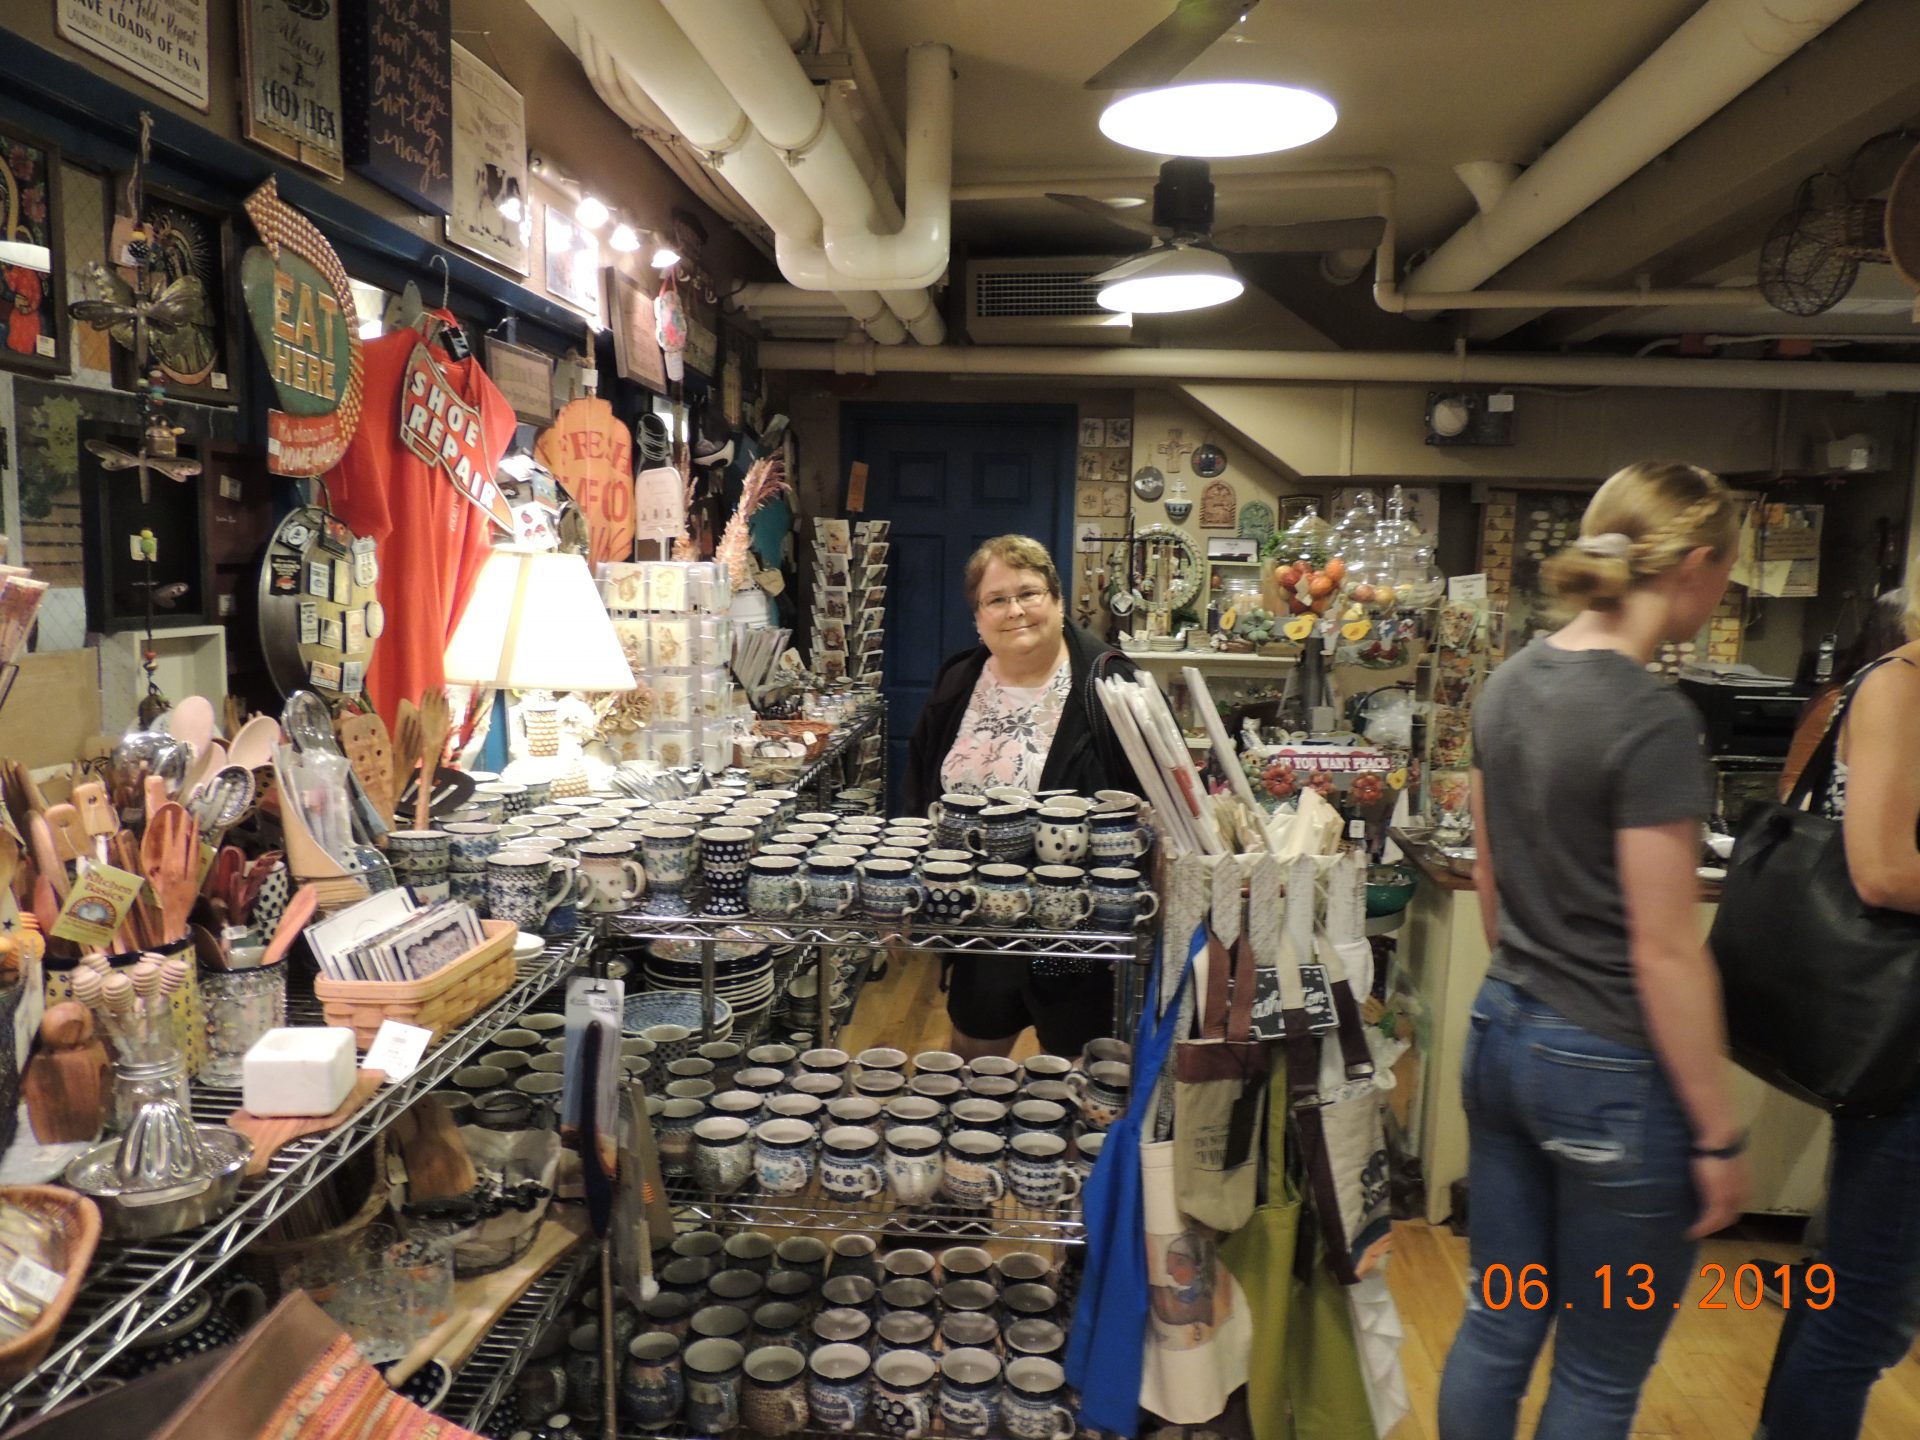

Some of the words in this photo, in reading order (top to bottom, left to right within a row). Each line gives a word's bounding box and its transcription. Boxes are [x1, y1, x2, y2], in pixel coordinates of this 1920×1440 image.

[109, 8, 152, 44] LOADS
[157, 36, 173, 55] OF
[178, 47, 201, 72] FUN
[371, 92, 410, 128] not
[374, 129, 449, 193] enough
[273, 267, 339, 359] EAT
[273, 339, 336, 401] HERE
[410, 371, 480, 448] SHOE
[408, 403, 498, 510] REPAIR
[1294, 757, 1318, 769] YOU
[1318, 757, 1352, 769] WANT
[1352, 757, 1390, 769] PEACE
[84, 882, 124, 902] Basics
[85, 871, 132, 895] Kitchen
